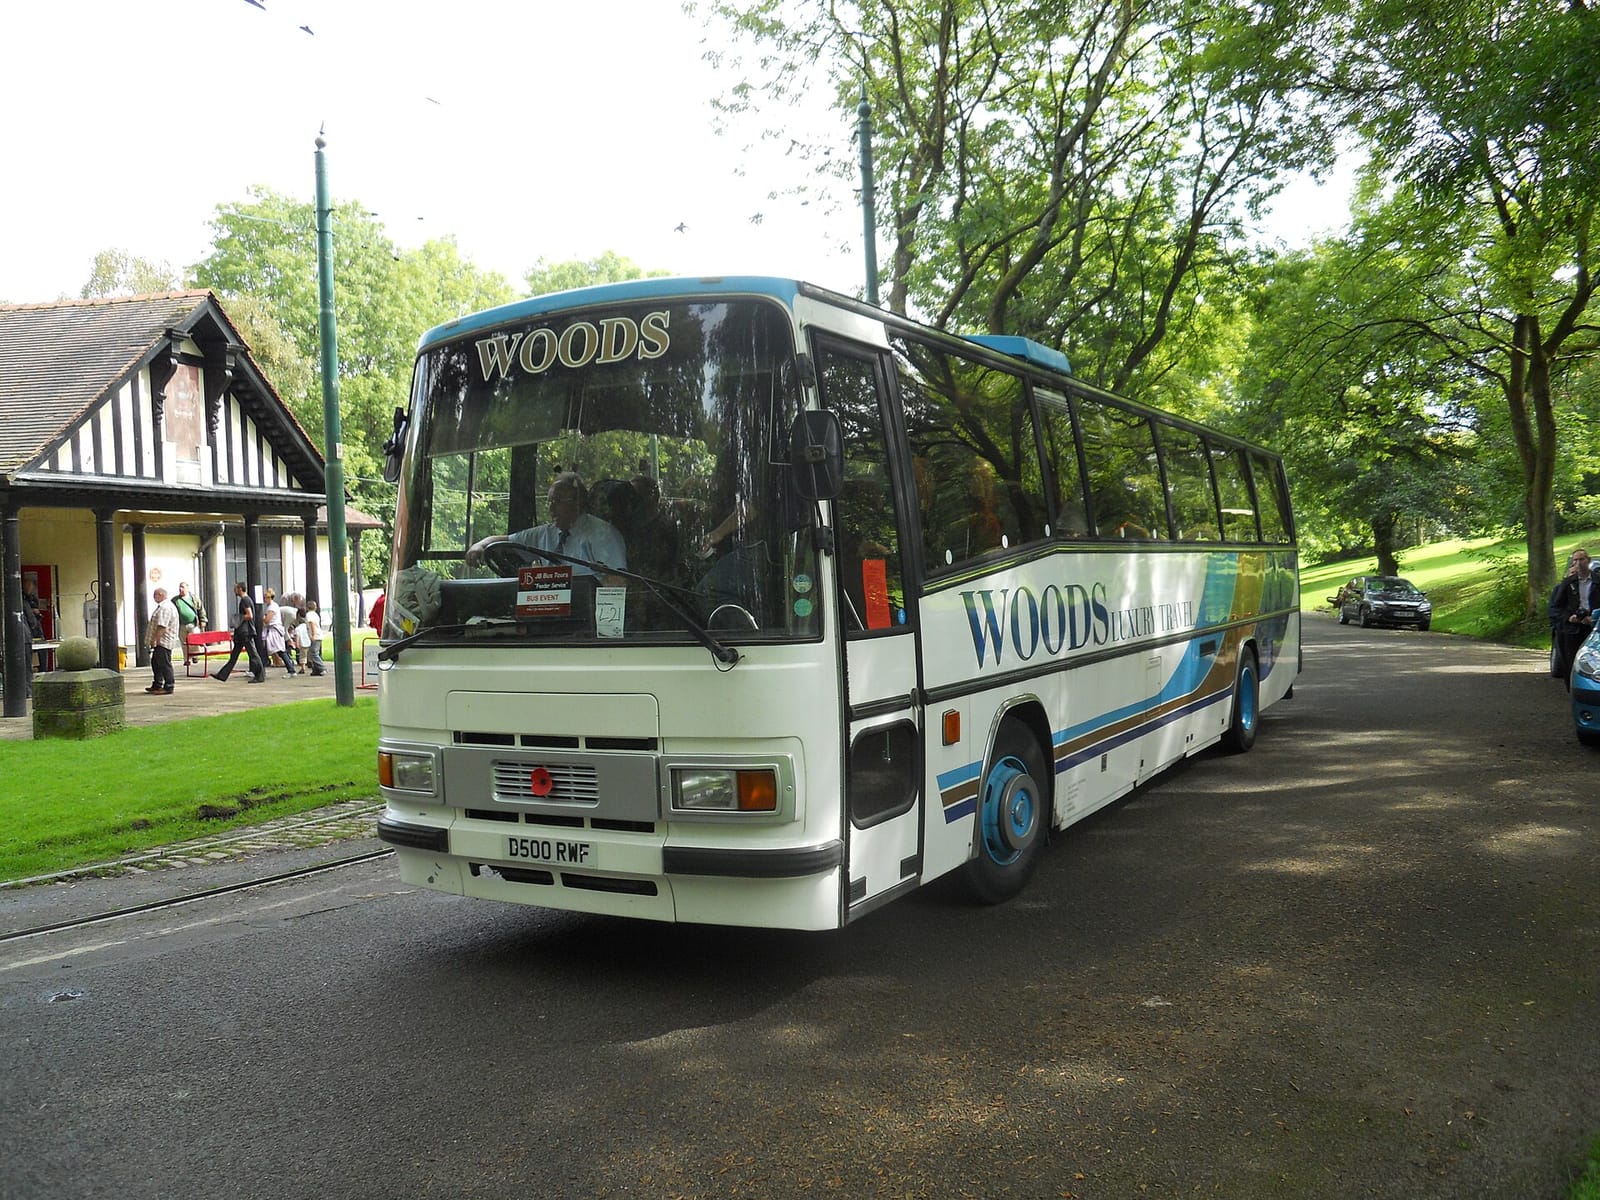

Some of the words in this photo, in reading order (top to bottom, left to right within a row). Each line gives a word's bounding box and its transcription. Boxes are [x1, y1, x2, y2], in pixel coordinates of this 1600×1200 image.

[475, 310, 671, 382] WOODS
[526, 594, 539, 602] BUS
[539, 593, 559, 601] EVENT
[959, 582, 1109, 670] WOODS
[1111, 605, 1156, 642] LUXURY
[1159, 600, 1196, 632] TRAVEL
[509, 837, 551, 860] D500
[556, 841, 590, 863] RWF
